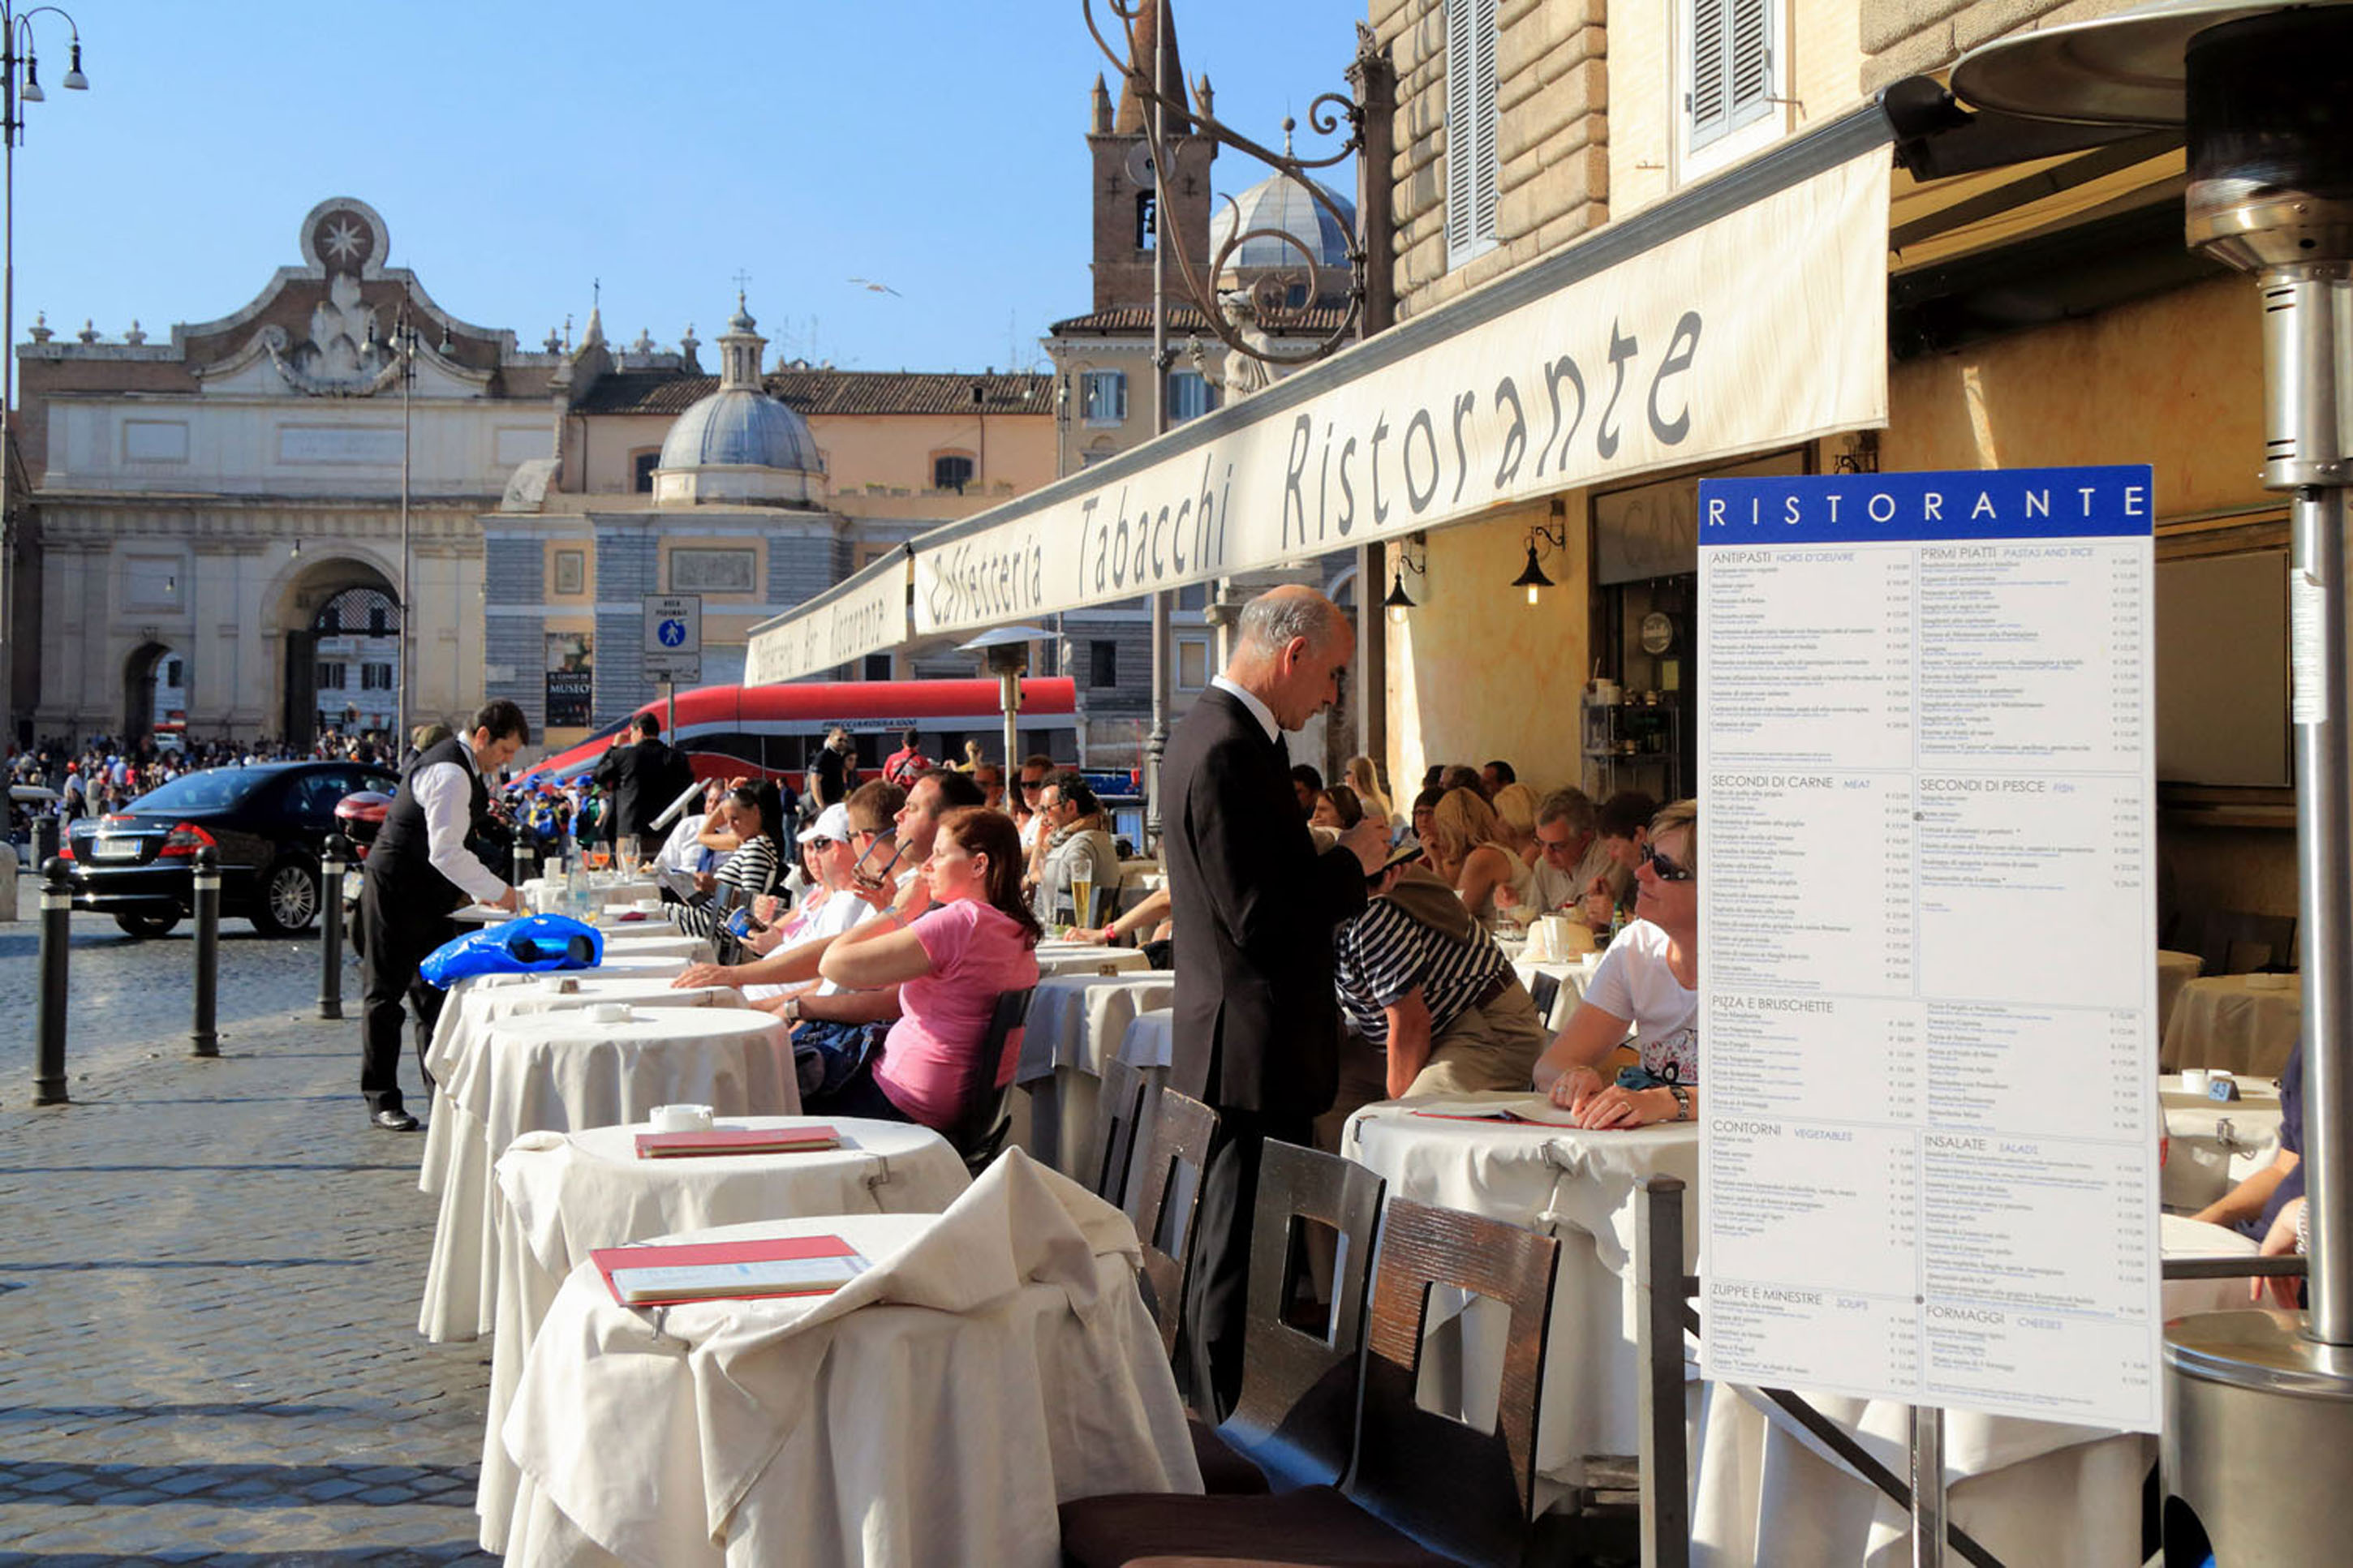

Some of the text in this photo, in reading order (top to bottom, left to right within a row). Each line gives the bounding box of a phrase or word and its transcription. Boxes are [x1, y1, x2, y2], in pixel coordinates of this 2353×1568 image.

[931, 311, 1702, 625] Caffetteria Tabacchi Ristorante
[1709, 487, 2144, 526] RISTORANTE
[1712, 552, 1771, 563] ANTIPASTI
[1777, 553, 1803, 562] HORS
[1921, 547, 2093, 559] PRIMI PIATTI PASTAS AND RICE
[1711, 775, 1769, 787] SECONDI
[1772, 775, 1784, 787] DI
[1788, 776, 1833, 788] CARNE
[1921, 779, 1981, 792] SECONDI
[1985, 780, 1999, 791] DI
[2003, 780, 2045, 793] PESCE
[1712, 995, 1833, 1013] PIZZA E BRUSCHETTE
[2212, 1083, 2227, 1098] 43
[1712, 1119, 1852, 1141] CONTORNI VEGETABLES
[1925, 1136, 1987, 1151] INSALATE
[1712, 1283, 1749, 1299] ZUPPE
[1753, 1287, 1761, 1299] E
[1763, 1290, 1822, 1305] MINESTRE
[1925, 1305, 2005, 1324] FORMAGGI
